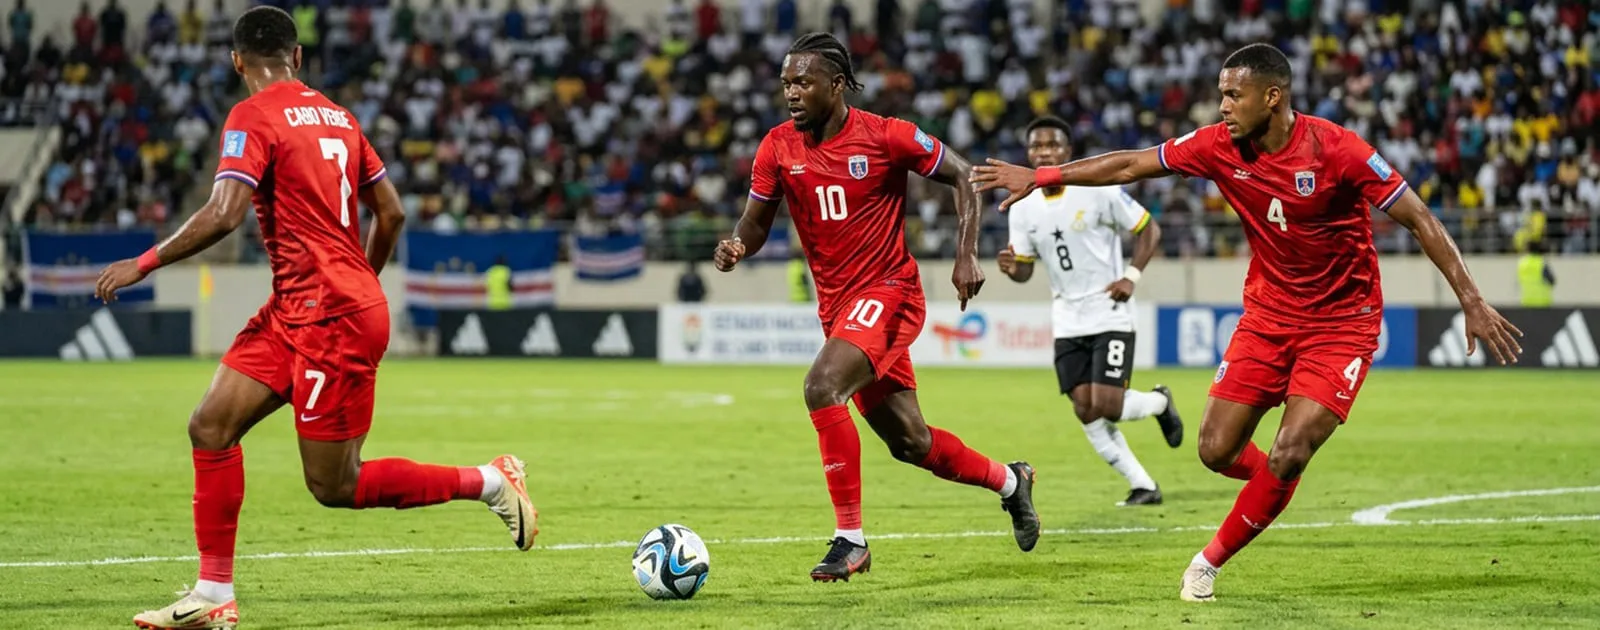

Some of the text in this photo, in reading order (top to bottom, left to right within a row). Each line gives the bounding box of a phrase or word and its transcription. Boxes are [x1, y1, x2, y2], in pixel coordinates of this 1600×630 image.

[283, 106, 321, 127] CABO
[318, 138, 352, 228] 7
[815, 185, 848, 221] 10
[1266, 197, 1288, 232] 4
[1056, 244, 1073, 272] 8
[847, 298, 885, 328] 10
[1107, 339, 1125, 366] 8
[305, 369, 326, 410] 7
[1343, 356, 1363, 390] 4
